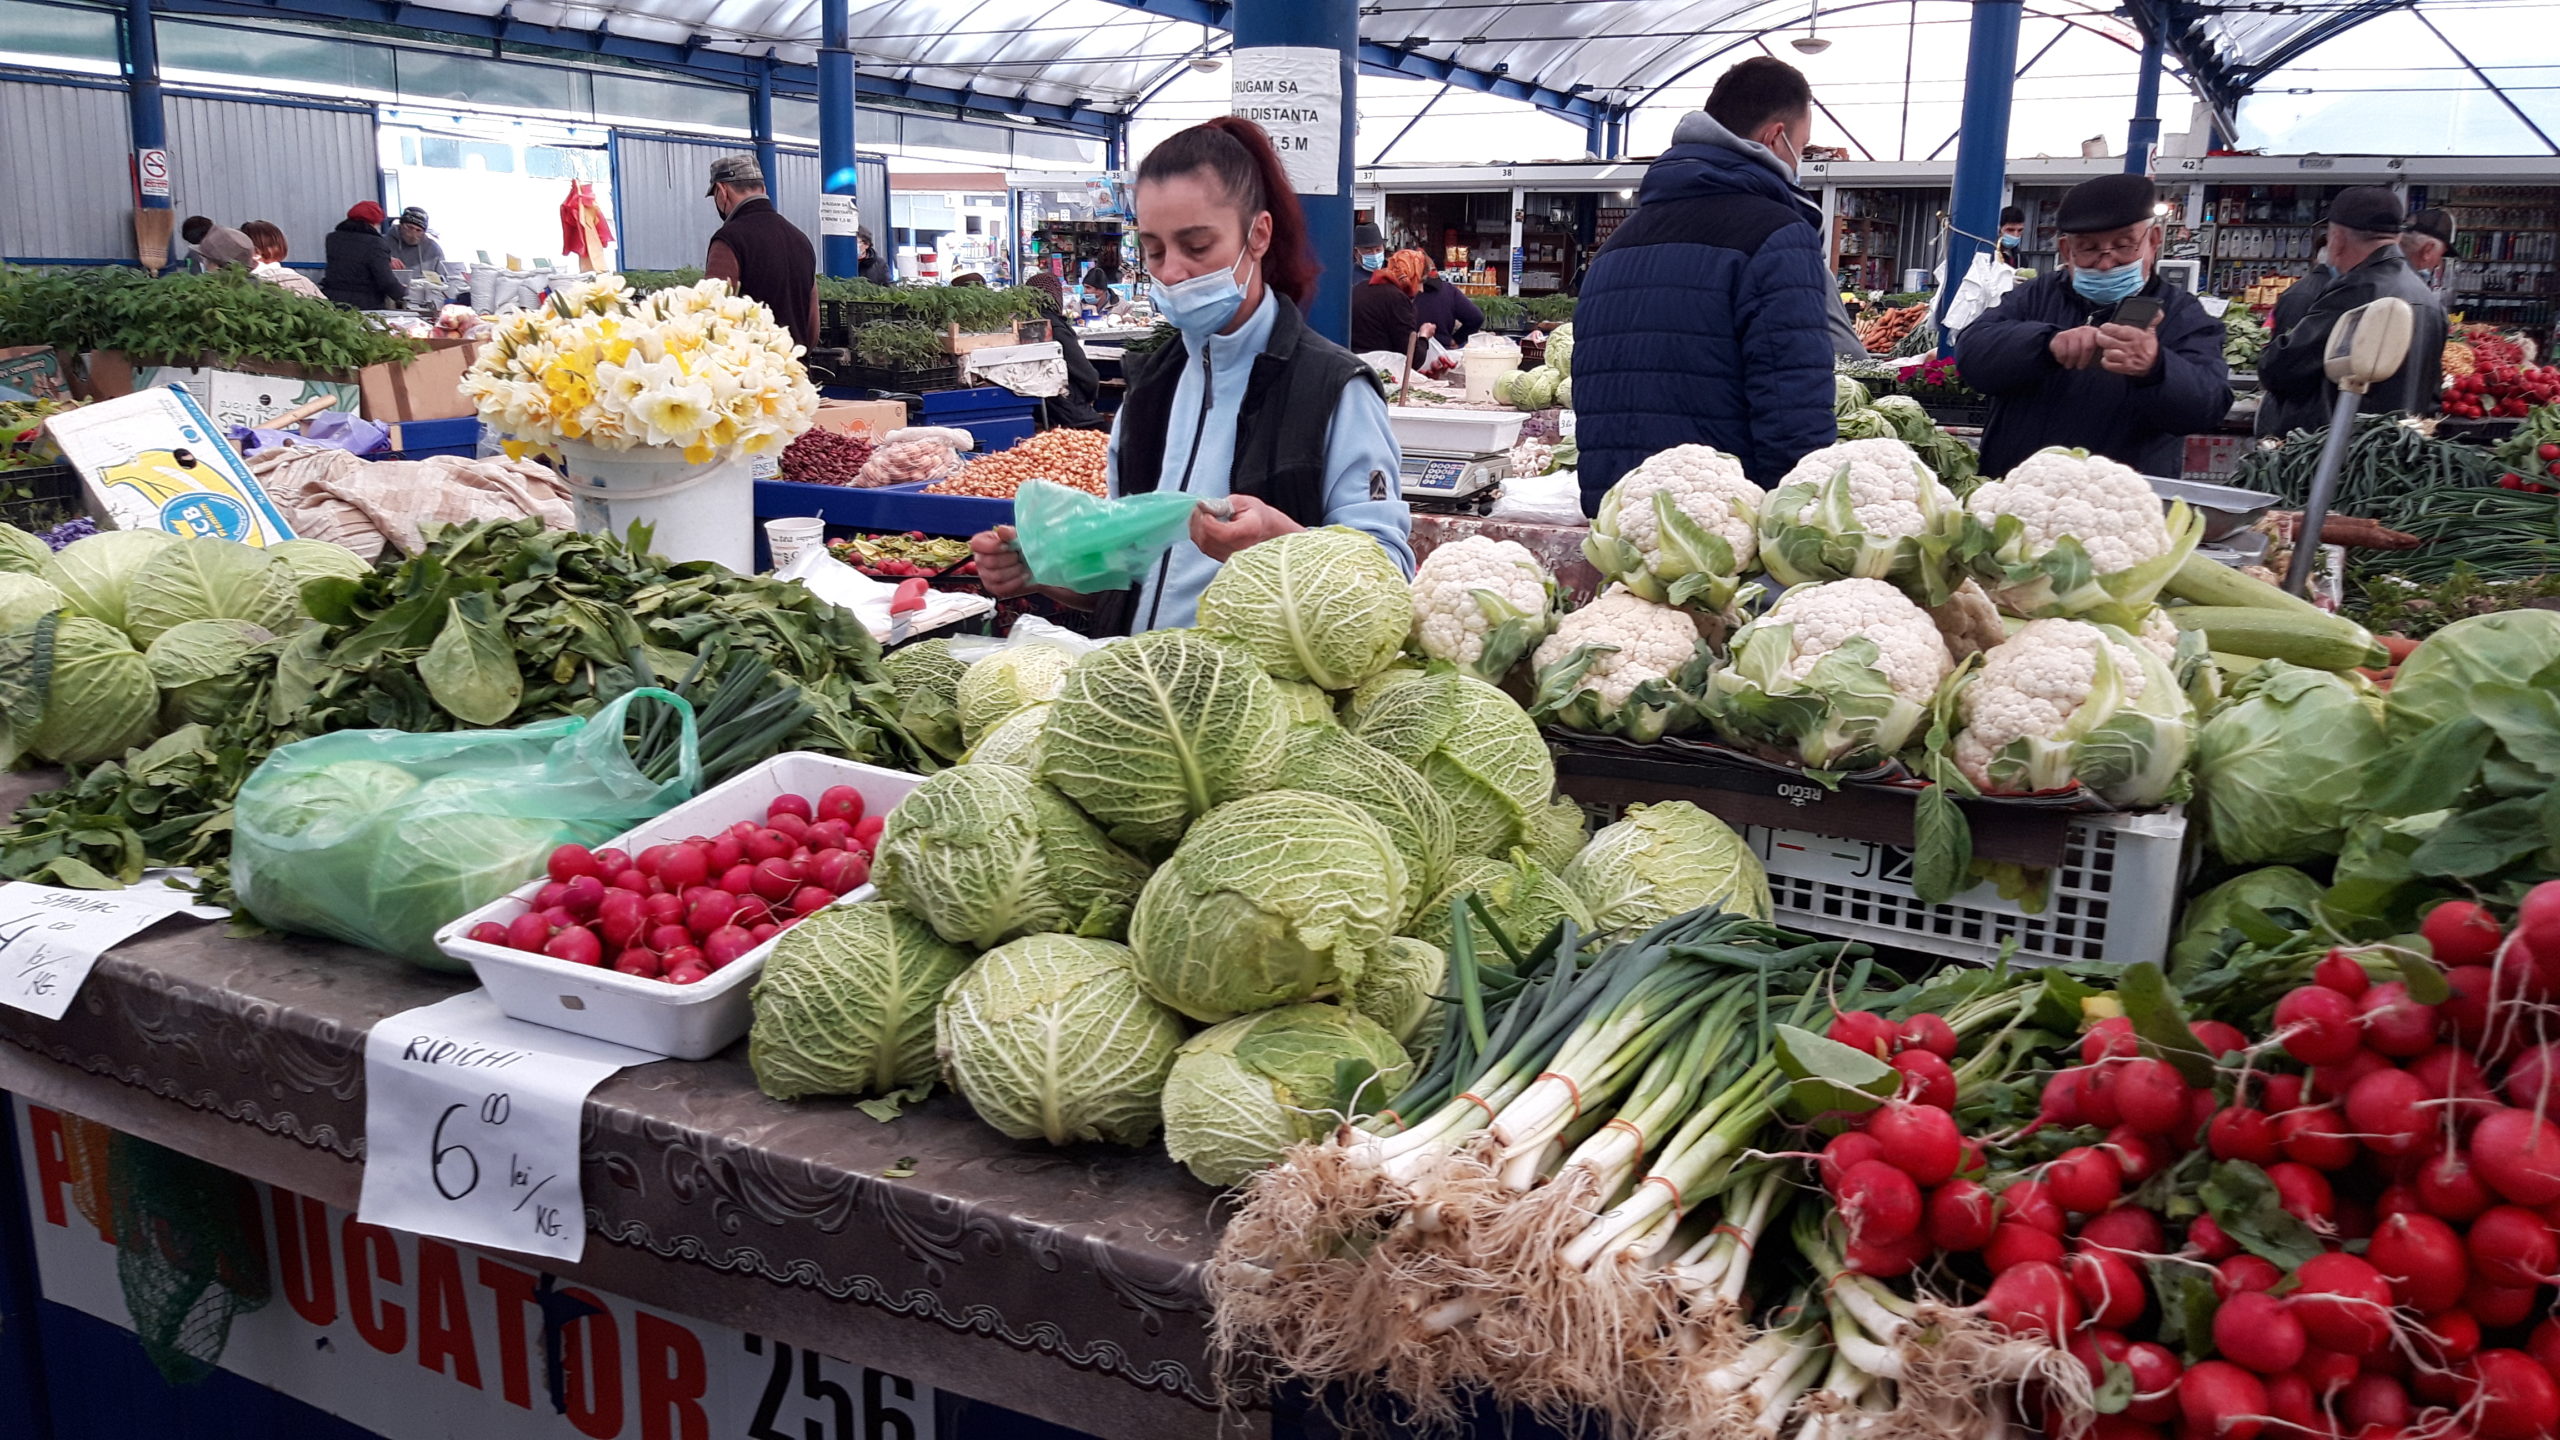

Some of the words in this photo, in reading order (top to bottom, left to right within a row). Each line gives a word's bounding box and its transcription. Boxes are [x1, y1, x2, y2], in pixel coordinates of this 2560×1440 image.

[1278, 81, 1299, 94] SA
[1251, 108, 1319, 122] DISTANTA
[1295, 137, 1308, 151] M
[1813, 164, 1825, 173] 40
[2182, 161, 2195, 170] 42
[1776, 783, 1823, 801] REGIO
[402, 1034, 533, 1069] RIDICHI
[431, 1103, 480, 1201] 6
[481, 1093, 511, 1125] 00
[744, 1332, 917, 1440] 256
